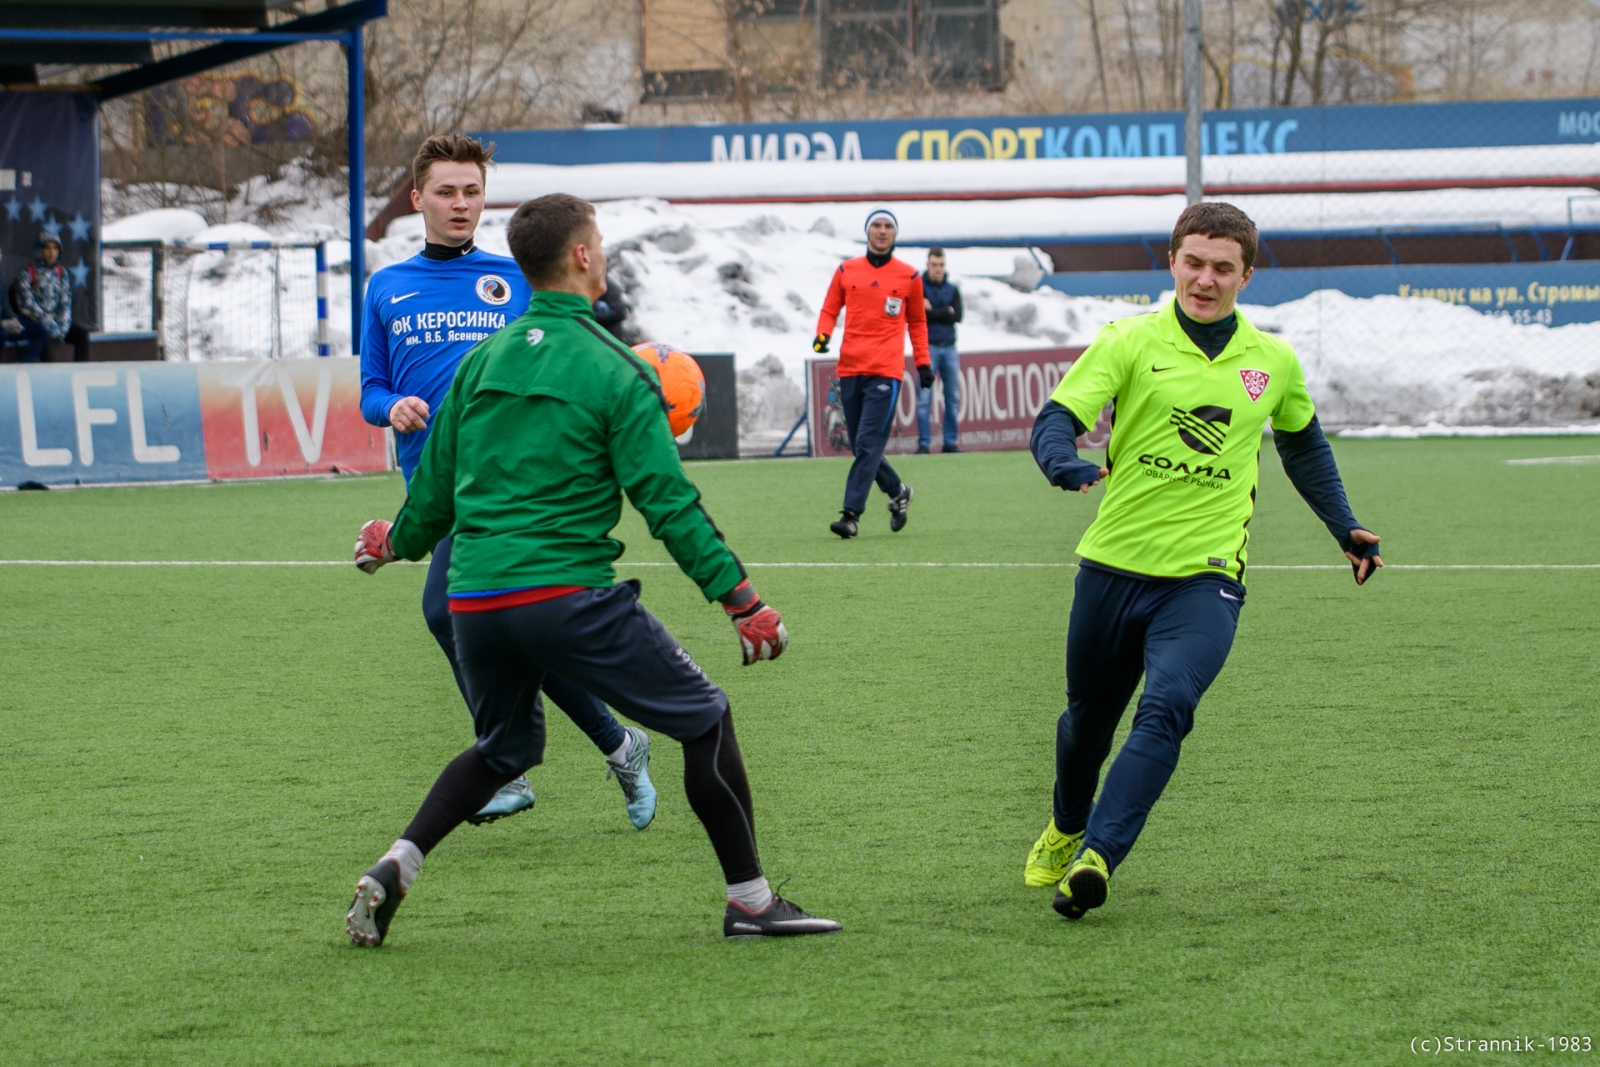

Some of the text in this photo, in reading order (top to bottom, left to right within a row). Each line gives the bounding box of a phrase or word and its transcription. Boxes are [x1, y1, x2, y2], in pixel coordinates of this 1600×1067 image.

[712, 119, 1299, 161] МИРЭА СПОРТКОМПЕКС
[1470, 287, 1493, 303] на
[392, 311, 506, 335] ФК КЕРОСИНКА
[406, 335, 422, 346] им.
[425, 331, 444, 343] В.Б.
[16, 366, 332, 466] LFL TV
[1138, 453, 1231, 480] СОЛИД
[1191, 477, 1224, 490] РЫНКИ
